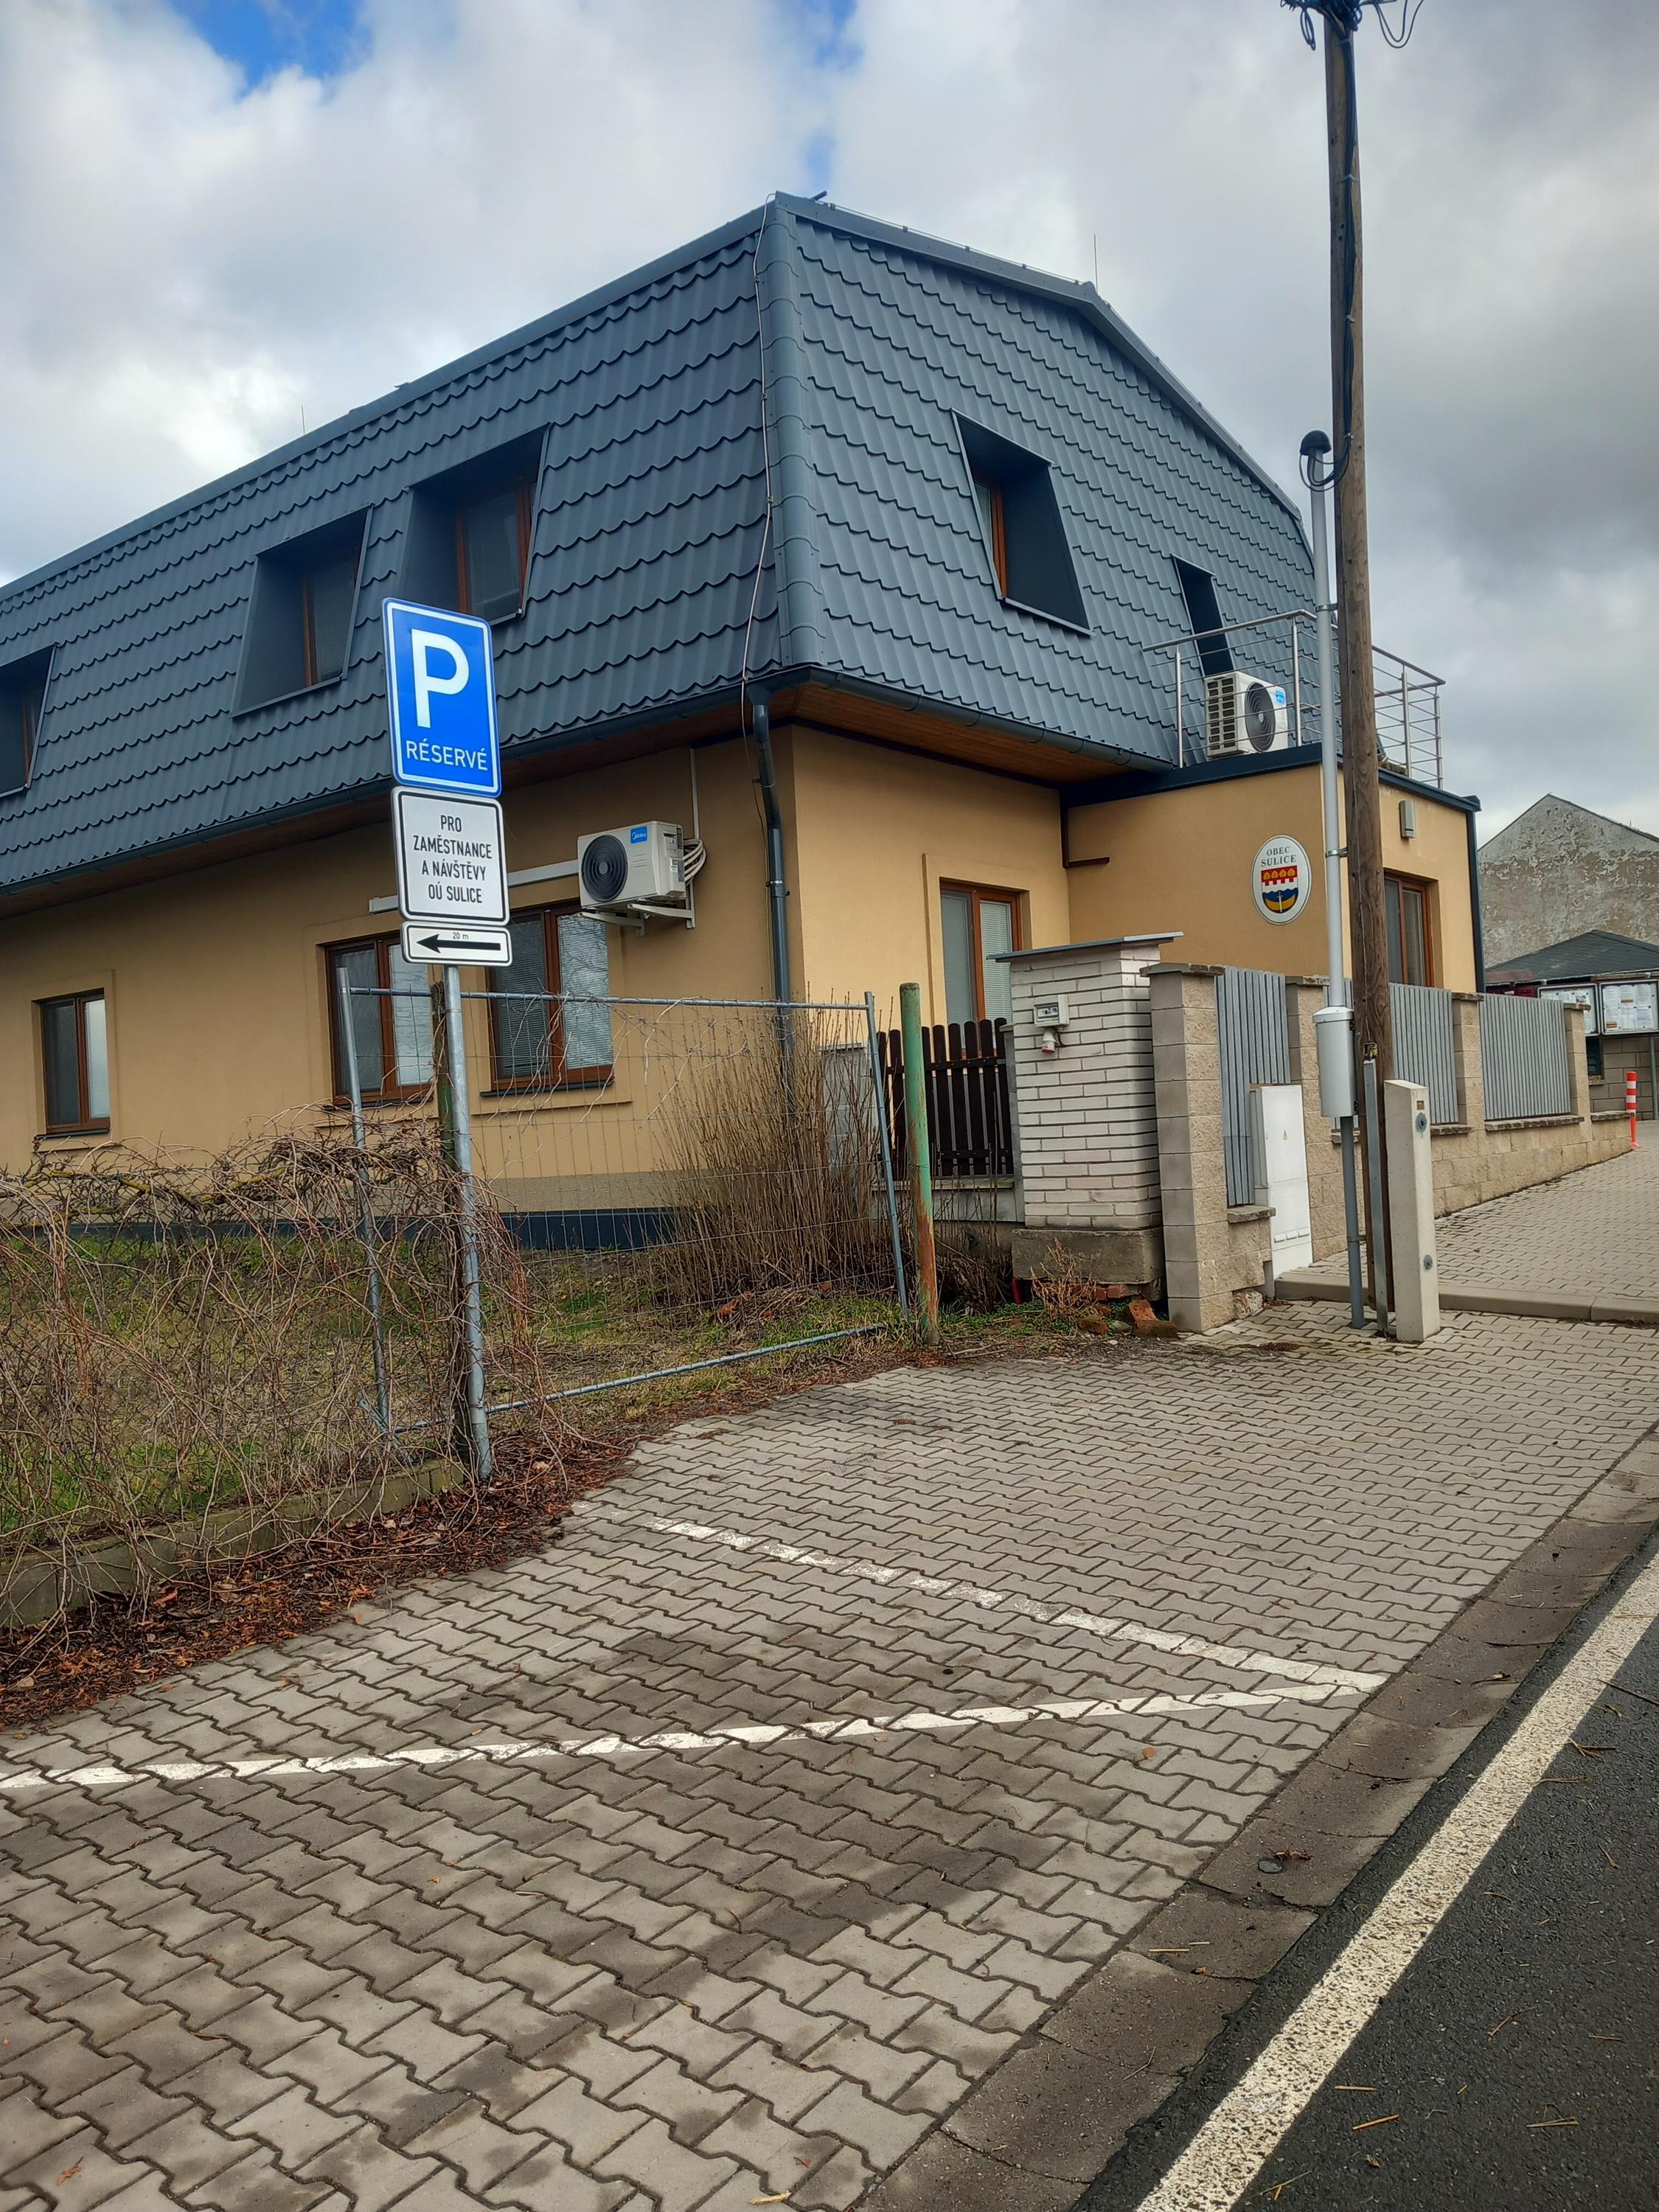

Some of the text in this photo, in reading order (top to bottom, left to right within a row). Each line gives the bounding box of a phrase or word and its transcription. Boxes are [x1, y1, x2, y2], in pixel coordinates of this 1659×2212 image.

[411, 628, 469, 728] P
[406, 738, 488, 771] RÉSERVÉ
[440, 815, 462, 832] PRO
[413, 835, 492, 859] ZAMĚSTNANCE
[1267, 846, 1290, 856] OBEC
[422, 858, 486, 881] A NÁVŠTĚVY
[1262, 855, 1296, 867] SULICE
[428, 882, 482, 903] OÚ SULICE
[452, 932, 461, 940] 20
